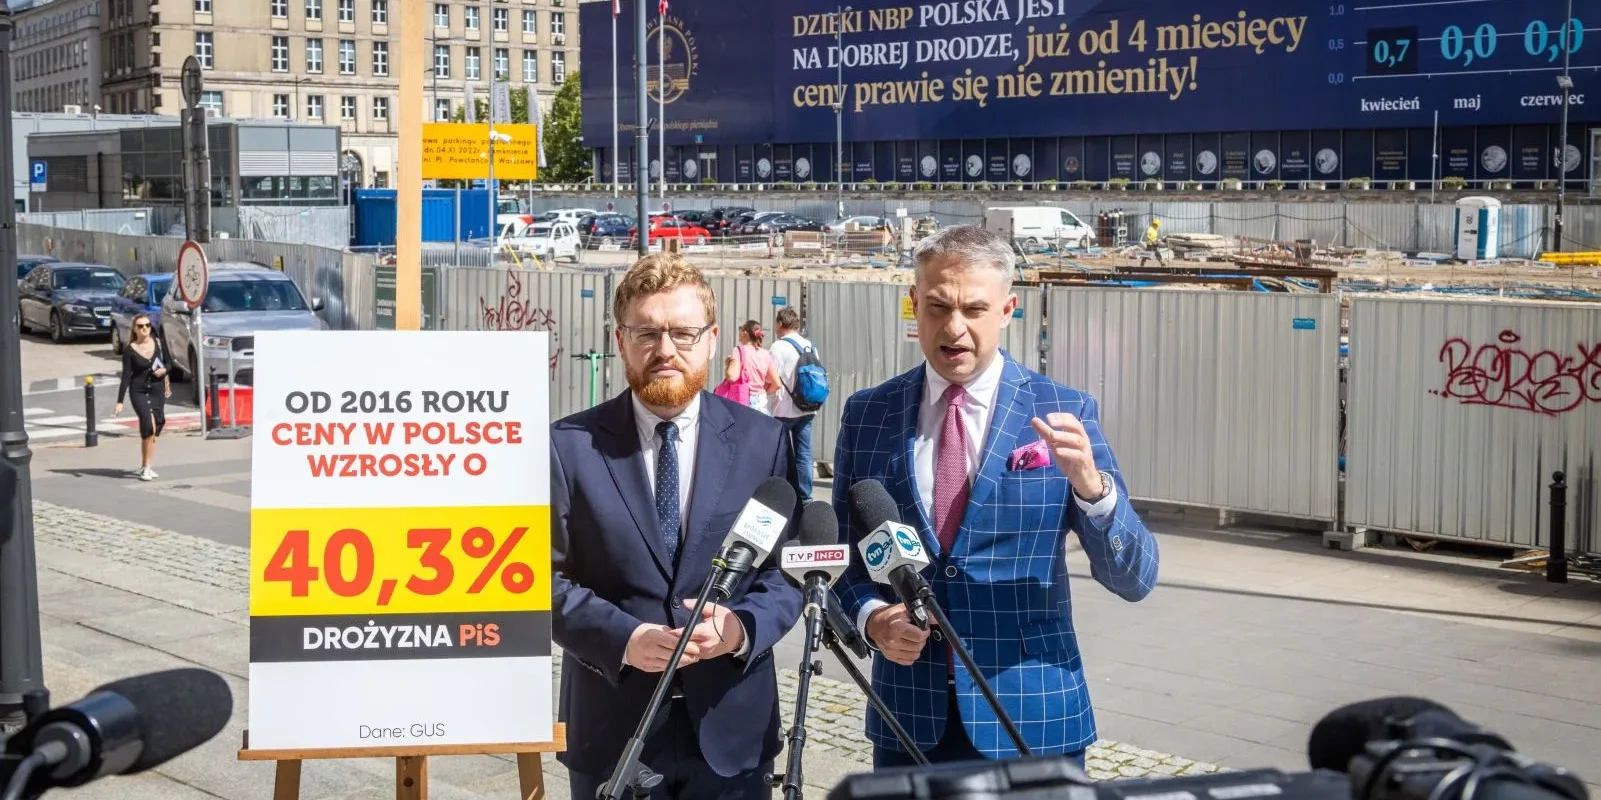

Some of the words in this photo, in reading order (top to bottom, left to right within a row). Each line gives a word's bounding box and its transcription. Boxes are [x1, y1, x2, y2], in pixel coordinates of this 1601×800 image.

[792, 11, 862, 40] DZIĘKI
[868, 7, 914, 31] NBP
[919, 0, 1010, 28] POLSKA
[792, 48, 822, 70] NA
[827, 41, 909, 70] DOBREJ
[915, 33, 1020, 64] DRODZE,
[1024, 22, 1071, 66] już
[1078, 19, 1120, 56] od
[1128, 19, 1148, 53] 4
[1155, 10, 1308, 55] miesięcy
[1440, 23, 1497, 66] 0,0
[1524, 18, 1584, 63] 0,0
[1374, 39, 1411, 67] 0,7
[793, 82, 848, 110] ceny
[854, 71, 945, 112] prawie
[952, 68, 988, 108] się
[996, 65, 1042, 99] nie
[1049, 56, 1198, 101] zmieniły!
[1361, 96, 1420, 112] kwiecień
[1454, 94, 1482, 111] maj
[1520, 94, 1585, 107] czerwec
[34, 163, 44, 177] P
[285, 390, 332, 414] OD
[340, 390, 413, 414] 2016
[422, 390, 510, 413] ROKU
[271, 422, 357, 446] CENY
[363, 422, 396, 445] W
[403, 421, 522, 445] POLSCE
[307, 453, 456, 478] WZROSŁY
[463, 453, 488, 476] O
[263, 526, 535, 607] 40,3%
[788, 552, 813, 562] TVP
[815, 550, 843, 560] INFO
[303, 620, 453, 650] DROŻYZNA
[459, 623, 501, 647] PiS
[359, 724, 406, 739] Dane:
[410, 723, 445, 737] GUS
